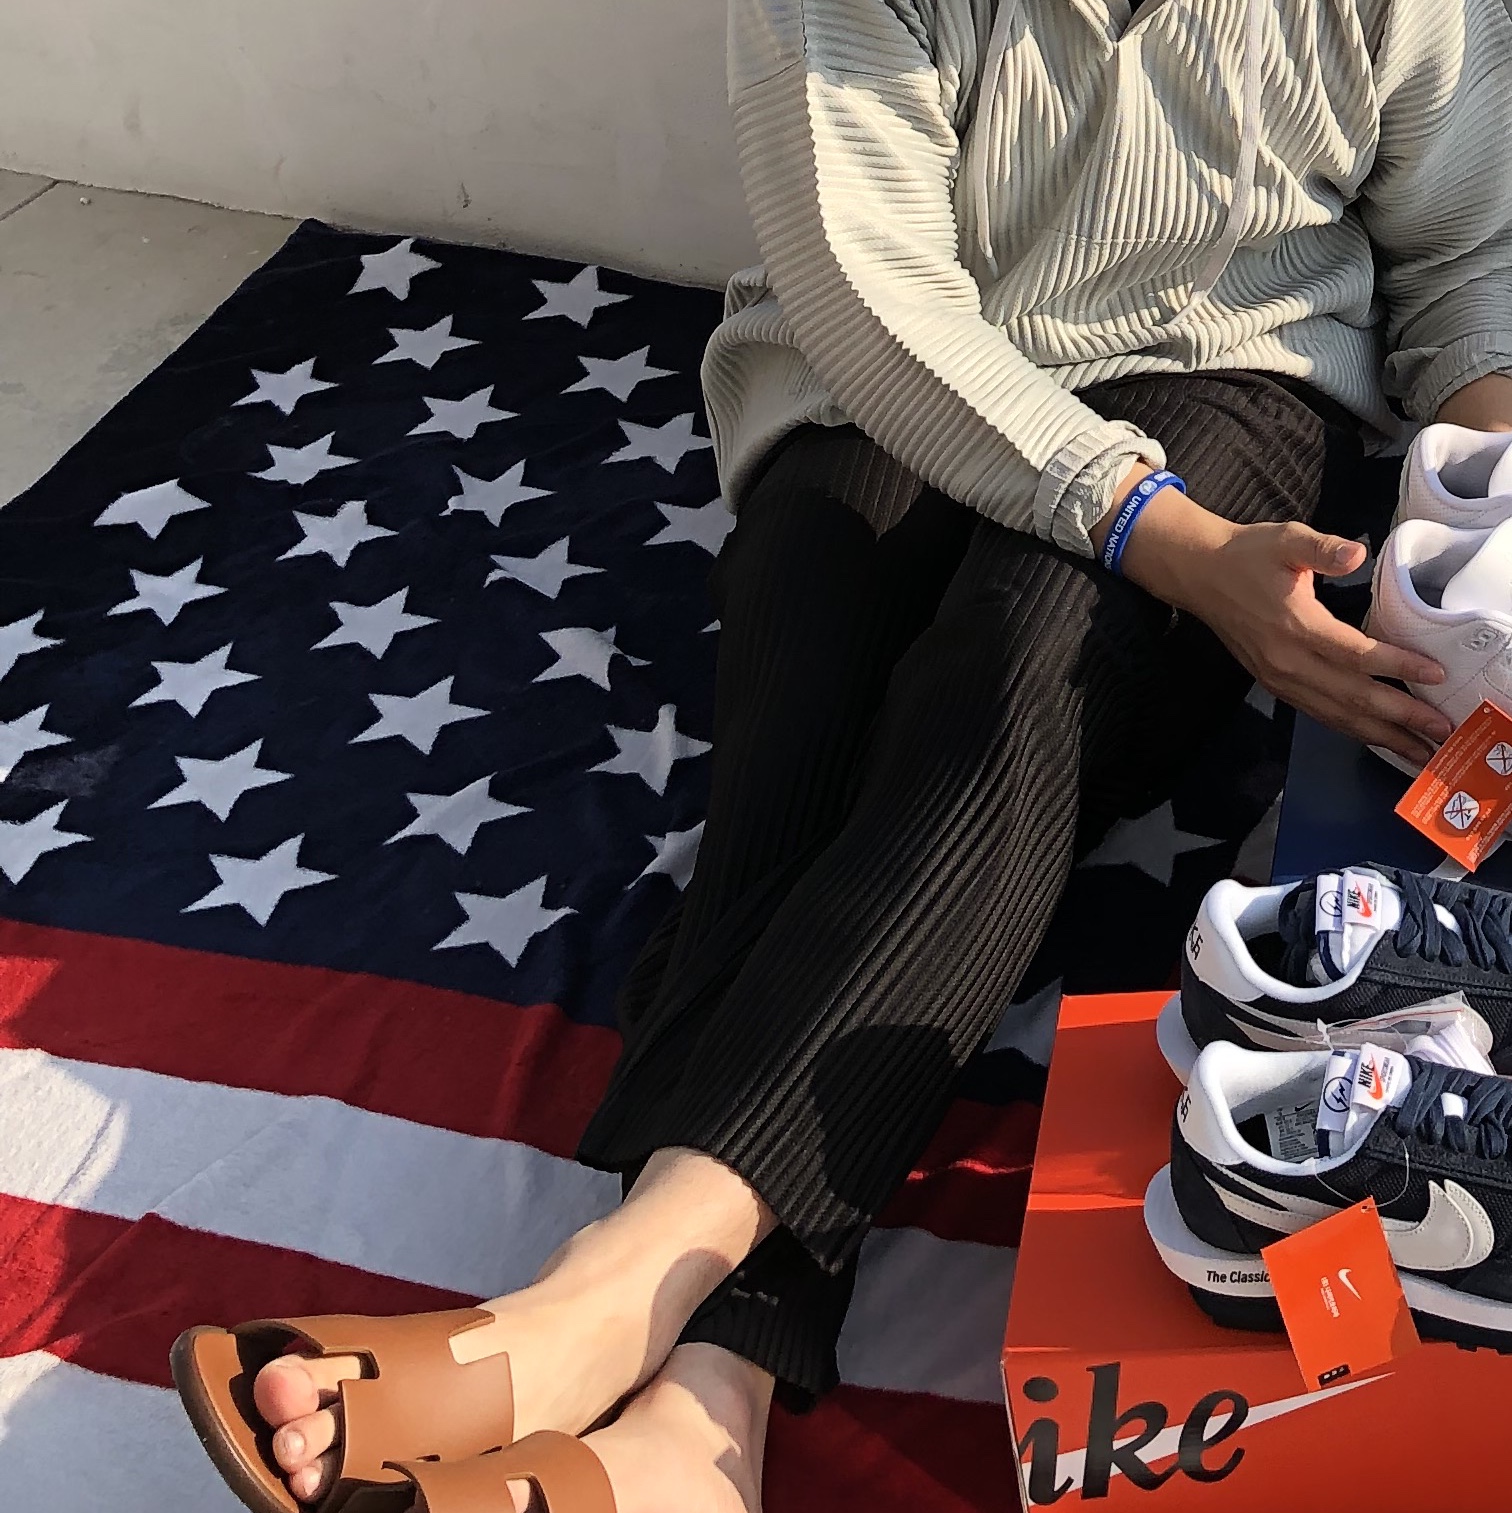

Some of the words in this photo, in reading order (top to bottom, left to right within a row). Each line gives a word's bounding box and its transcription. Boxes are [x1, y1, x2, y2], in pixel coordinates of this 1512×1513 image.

[1114, 495, 1142, 534] UNITED
[1357, 1062, 1375, 1089] NIKE
[1207, 1270, 1228, 1283] The
[1230, 1270, 1271, 1284] Classic
